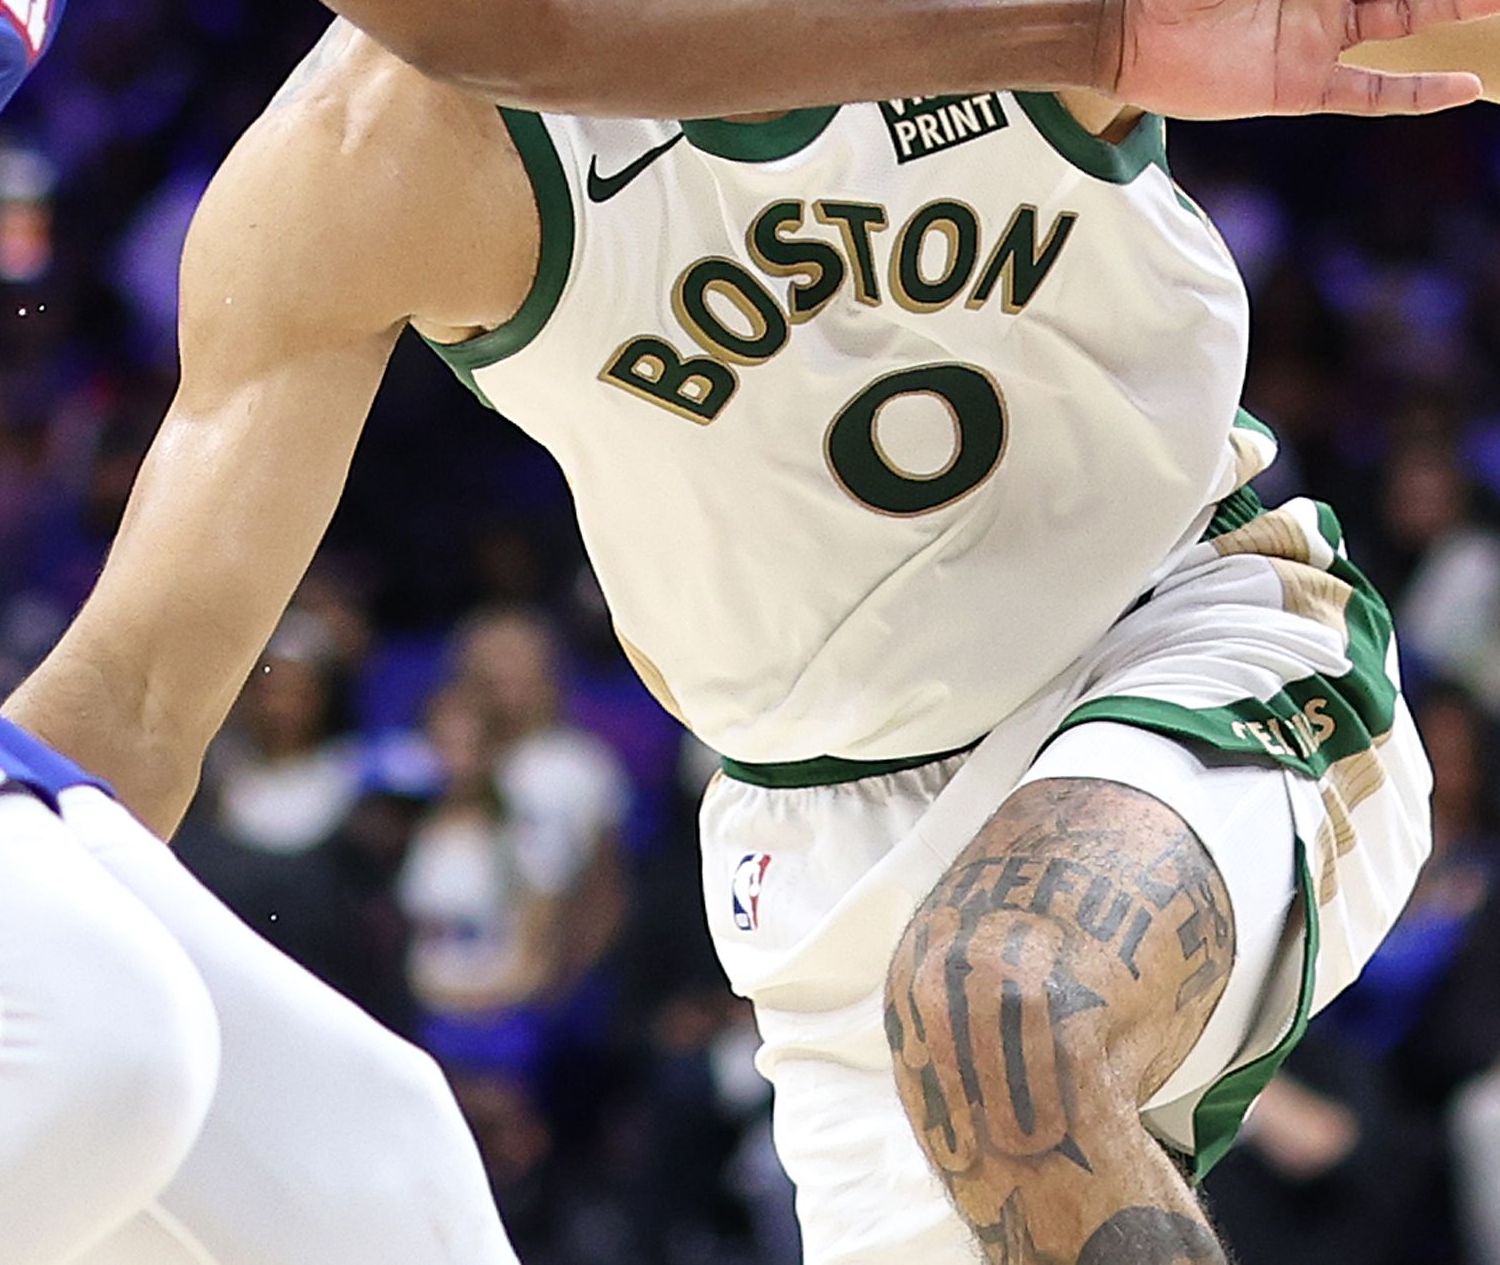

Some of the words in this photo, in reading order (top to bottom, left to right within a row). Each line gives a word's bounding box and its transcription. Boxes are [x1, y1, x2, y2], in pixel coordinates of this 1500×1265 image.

[893, 93, 998, 156] PRINT
[597, 197, 1079, 426] BOSTON
[822, 361, 1009, 519] 0
